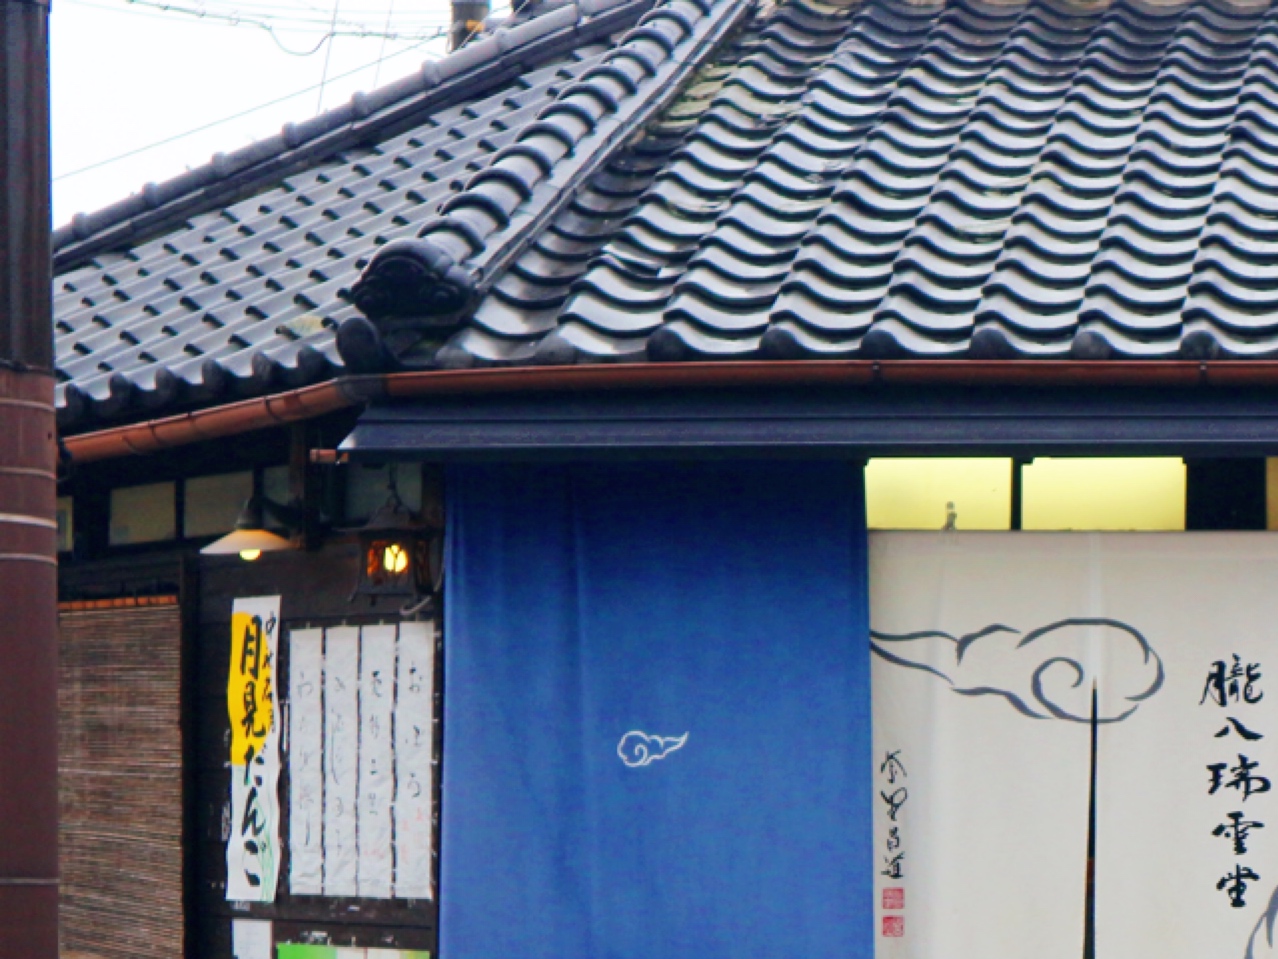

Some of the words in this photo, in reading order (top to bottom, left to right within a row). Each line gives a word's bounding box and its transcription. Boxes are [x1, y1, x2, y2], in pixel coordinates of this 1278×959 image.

[240, 614, 267, 888] 月見だんご
[1199, 653, 1272, 908] 朧八瑞雲堂
